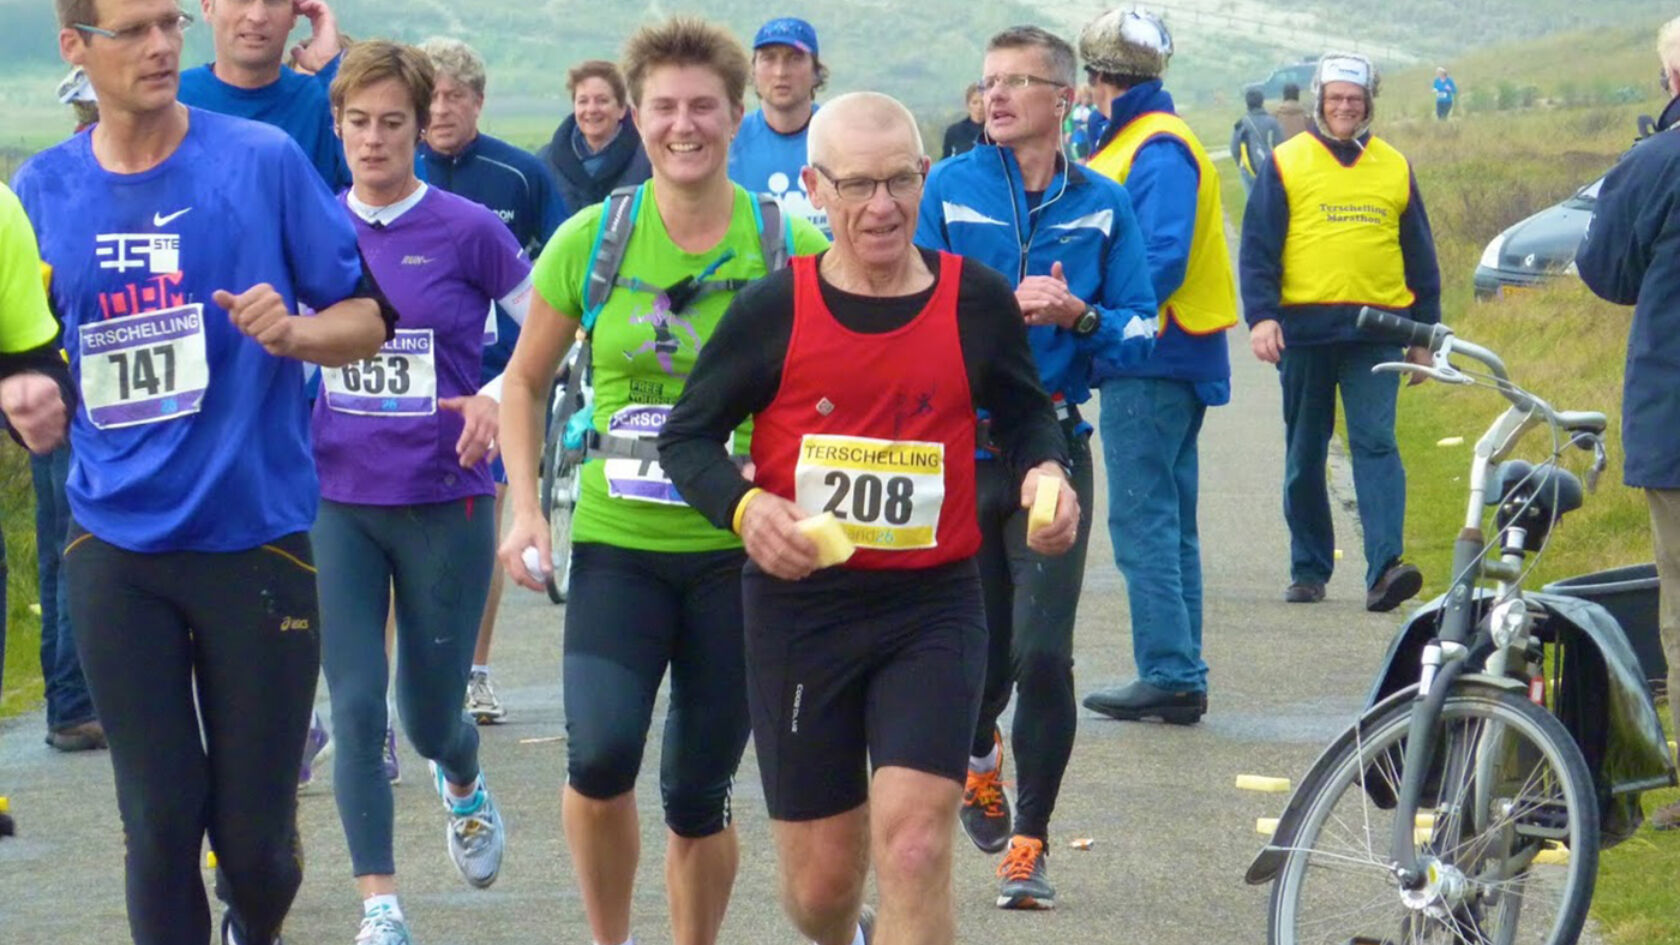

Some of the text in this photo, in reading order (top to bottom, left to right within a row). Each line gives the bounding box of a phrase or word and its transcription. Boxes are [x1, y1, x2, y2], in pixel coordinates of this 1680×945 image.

[1319, 203, 1387, 216] Terschelling
[1326, 214, 1382, 225] Marathon
[108, 343, 176, 401] 747
[341, 356, 411, 395] 653
[805, 443, 939, 468] TERSCHELLING
[822, 470, 915, 526] 208
